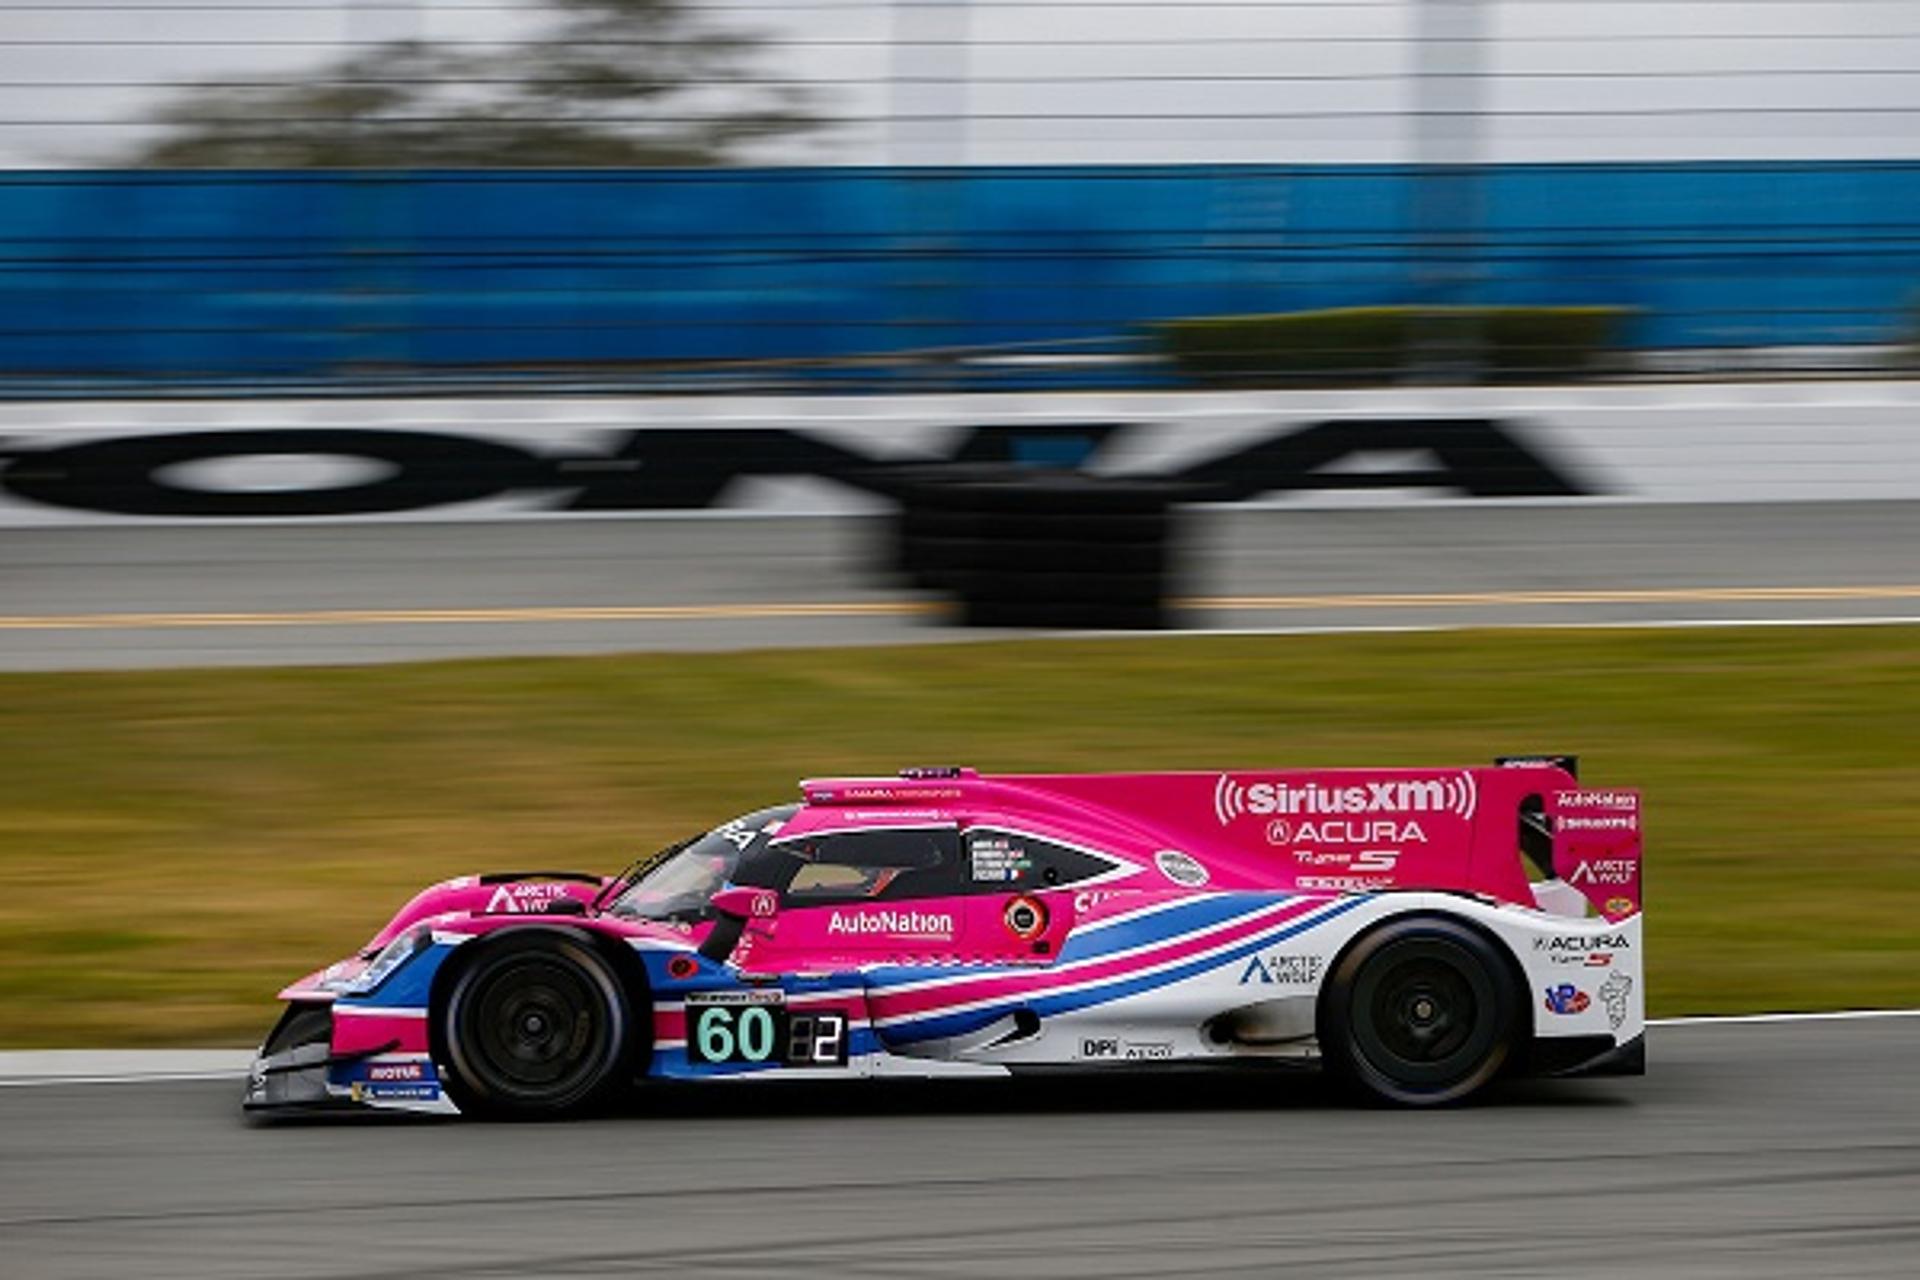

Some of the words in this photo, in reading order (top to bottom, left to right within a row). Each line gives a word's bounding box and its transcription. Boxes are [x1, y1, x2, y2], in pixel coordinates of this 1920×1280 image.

[1293, 822, 1428, 843] ACURA
[1348, 850, 1400, 871] S
[828, 911, 953, 934] AutoNation
[1550, 934, 1630, 951] ACURA
[697, 1006, 775, 1062] 60
[812, 1016, 843, 1061] 2
